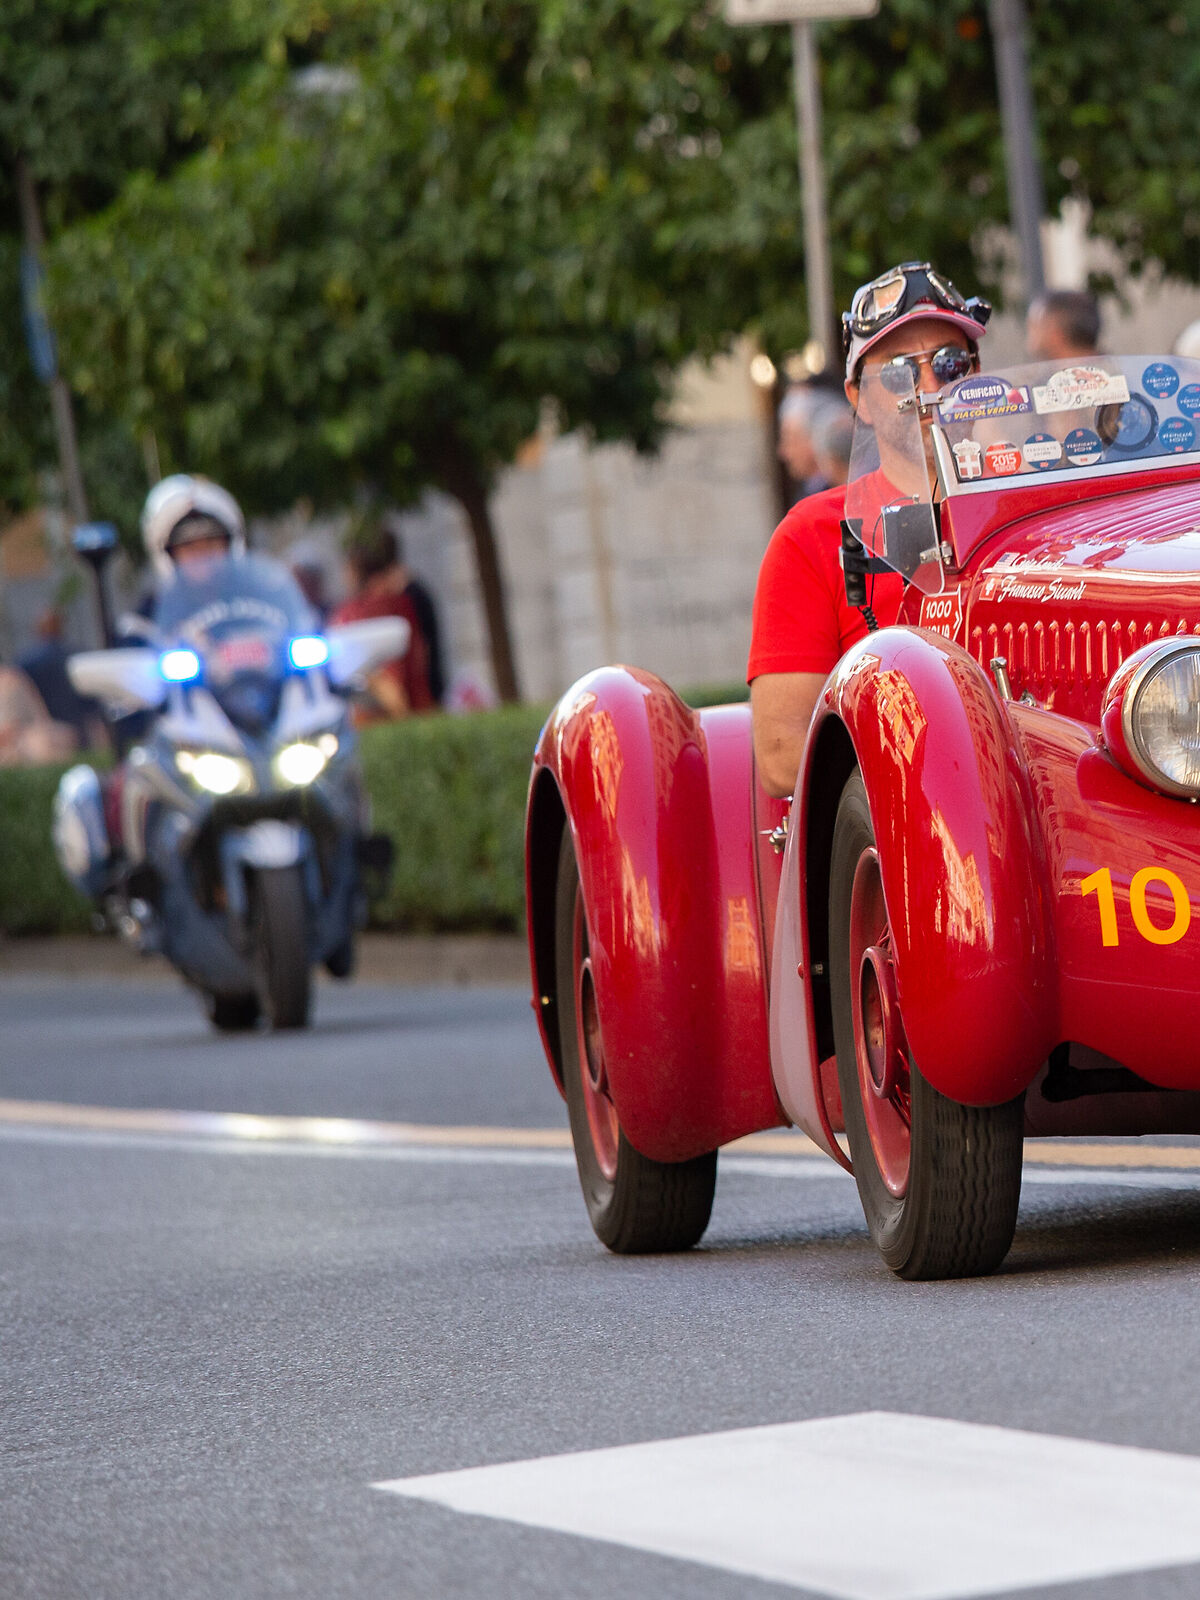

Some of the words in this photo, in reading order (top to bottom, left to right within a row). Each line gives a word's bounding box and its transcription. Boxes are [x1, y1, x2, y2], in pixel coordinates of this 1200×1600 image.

[961, 385, 1003, 400] VERIFICATO
[954, 412, 969, 420] VIA
[969, 409, 986, 418] COL
[986, 404, 1018, 416] VENTO
[991, 453, 1017, 468] 2015
[997, 575, 1046, 603] Francesco
[1041, 577, 1087, 603] Siccardi
[926, 600, 952, 619] 1000
